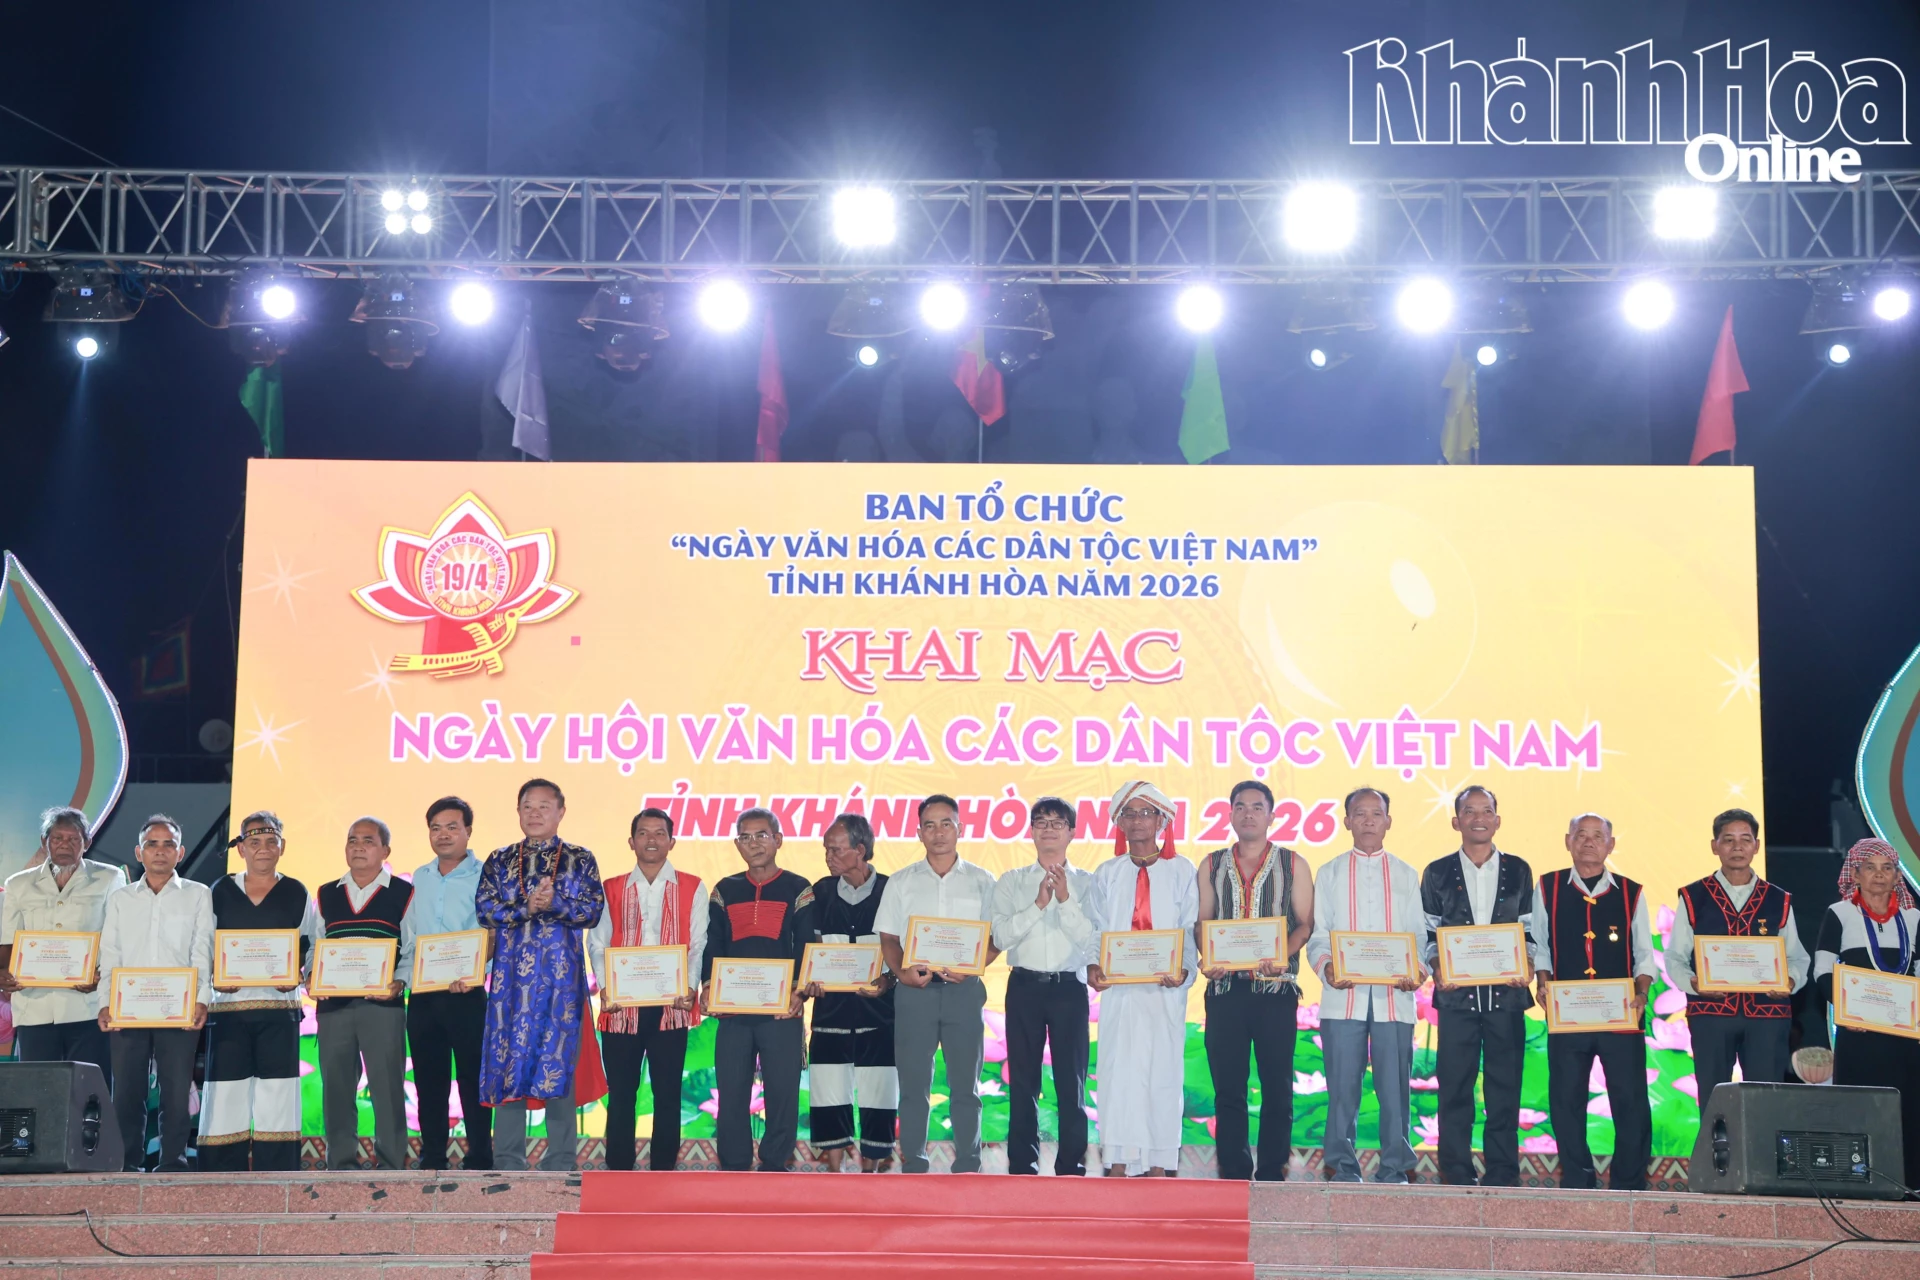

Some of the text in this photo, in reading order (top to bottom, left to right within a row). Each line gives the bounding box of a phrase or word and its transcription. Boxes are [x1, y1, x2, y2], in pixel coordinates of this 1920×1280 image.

[866, 481, 1123, 523] BAN TỔ CHỨC
[783, 530, 848, 558] VĂN
[858, 529, 926, 559] HÓA
[934, 530, 996, 559] CÁC
[1005, 531, 1071, 560] DÂN
[1079, 531, 1141, 566] TỘC
[1148, 532, 1217, 566] VIỆT
[441, 563, 488, 591] 19/4
[767, 565, 1220, 597] TỈNH KHÁNH HÒA NĂM 2026
[801, 627, 1184, 692] KHAI MẠC
[393, 702, 1599, 779] NGÀY HỘI VĂN HÓA CÁC DÂN TỘC VIỆT NAM
[957, 787, 1032, 839] HÒ
[1196, 800, 1337, 843] 226
